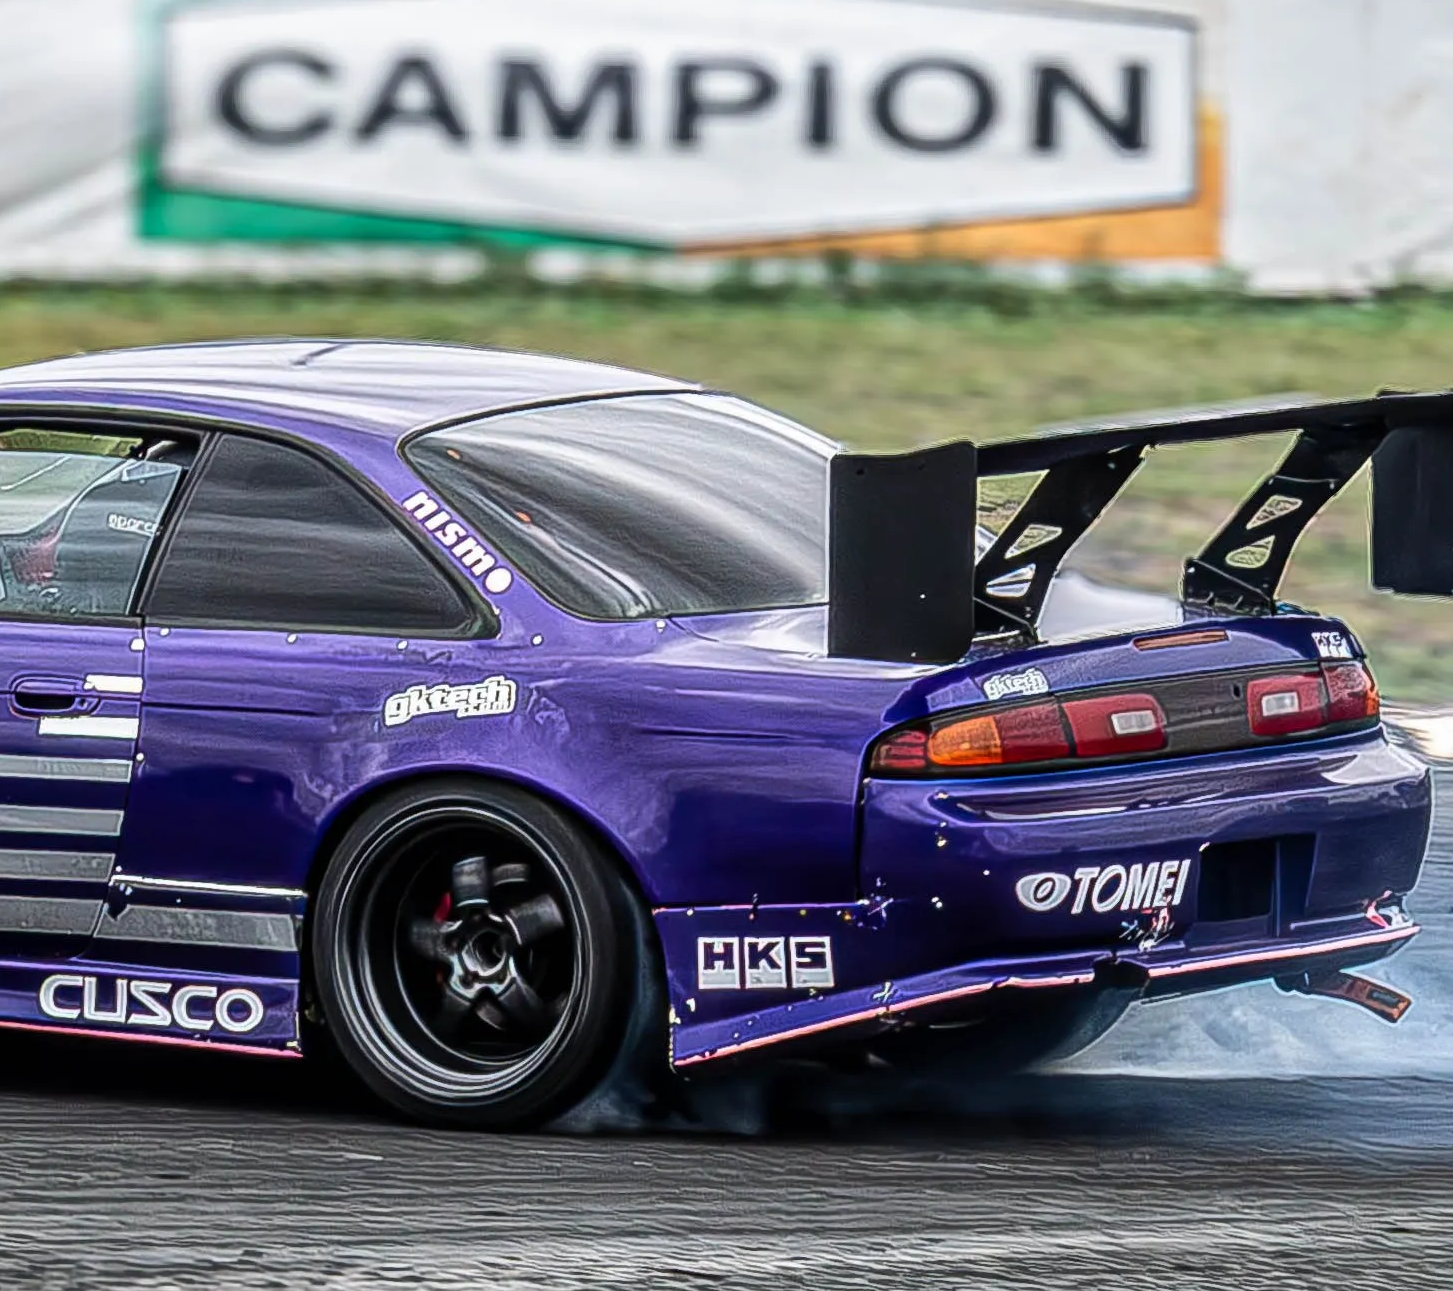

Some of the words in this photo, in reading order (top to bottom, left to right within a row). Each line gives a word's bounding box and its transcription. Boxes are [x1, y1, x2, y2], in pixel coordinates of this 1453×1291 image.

[215, 48, 1151, 154] CAMPION
[402, 491, 512, 593] nismo
[1071, 859, 1191, 914] TOMEI
[700, 939, 831, 977] HKS
[39, 974, 264, 1032] CUSCO
